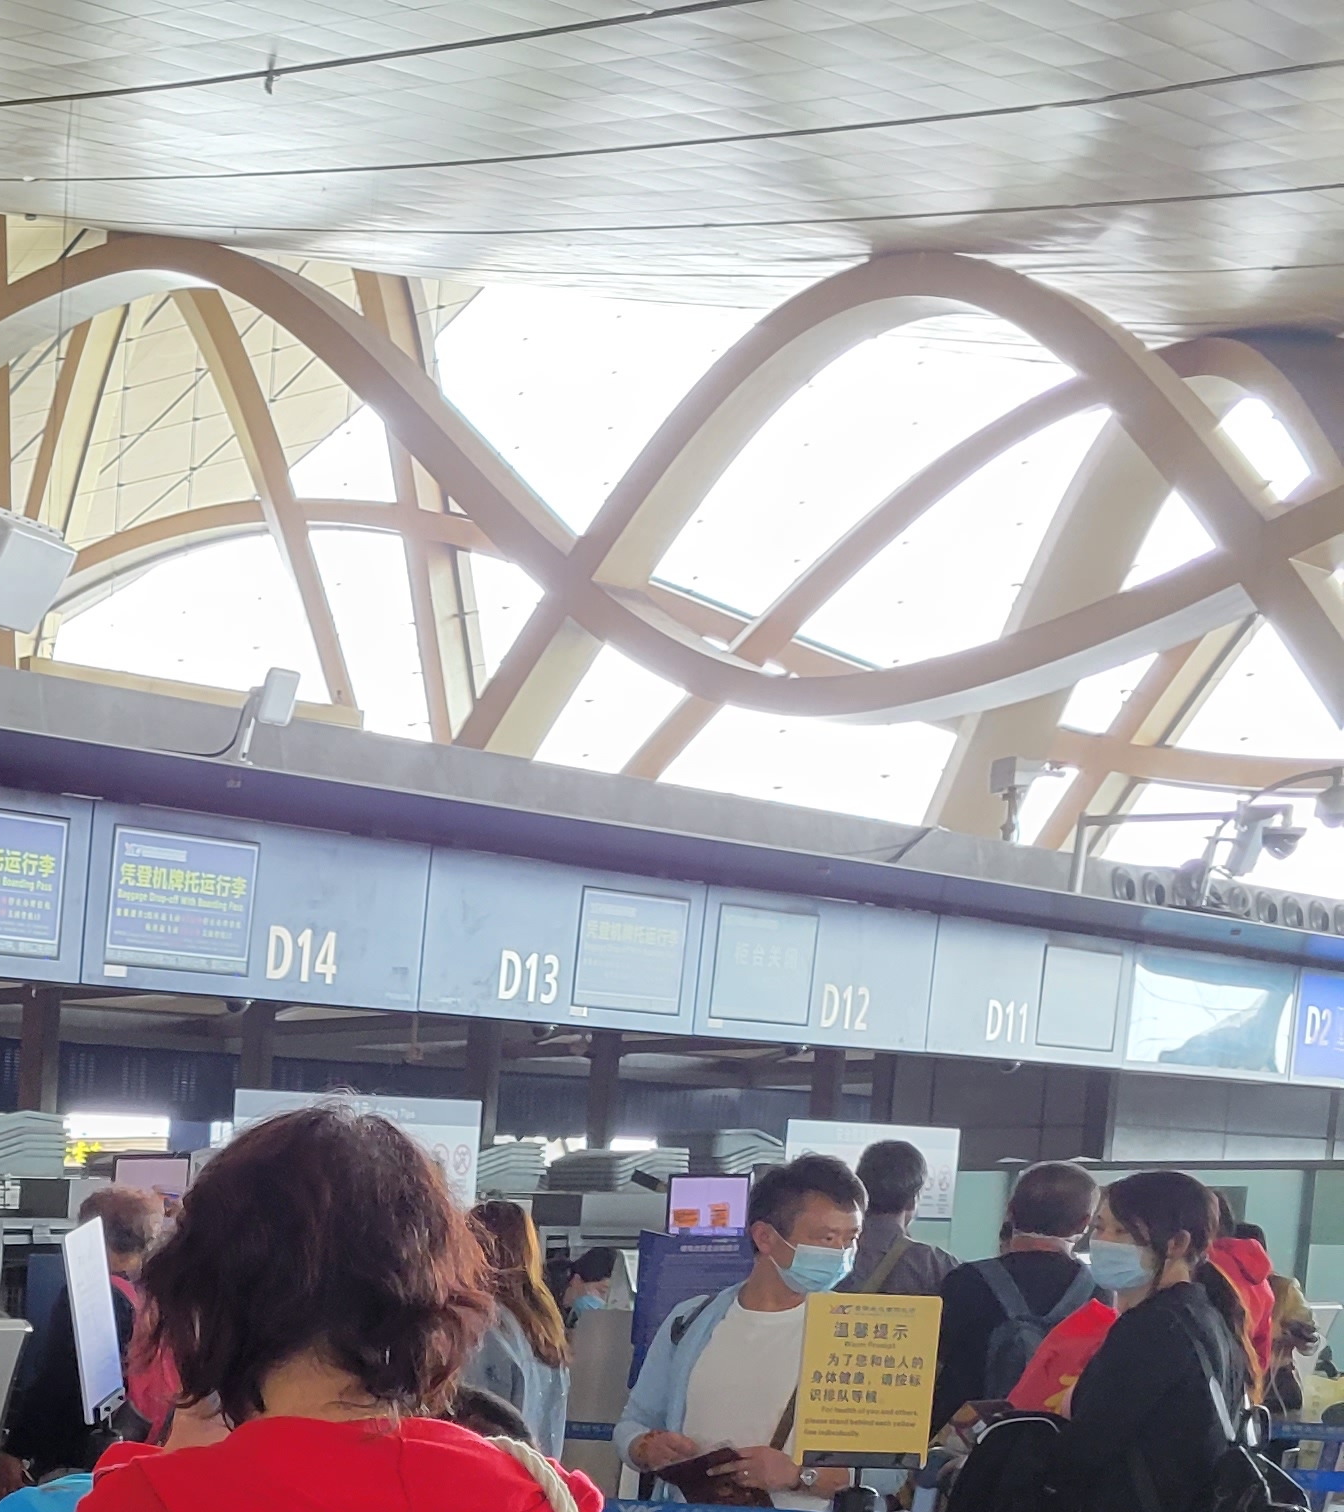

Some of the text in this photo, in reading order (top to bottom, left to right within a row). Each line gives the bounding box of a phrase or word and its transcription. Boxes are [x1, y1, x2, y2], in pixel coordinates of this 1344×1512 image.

[119, 862, 247, 899] 凭登机牌托运行李
[265, 925, 338, 985] D14
[498, 949, 560, 1005] D13
[820, 984, 871, 1031] D12
[985, 999, 1030, 1044] D11
[1304, 1005, 1332, 1046] D2
[834, 1322, 909, 1340] 温馨提示
[827, 1353, 924, 1369] 为了您和他人的
[810, 1388, 877, 1403] 识排队等候
